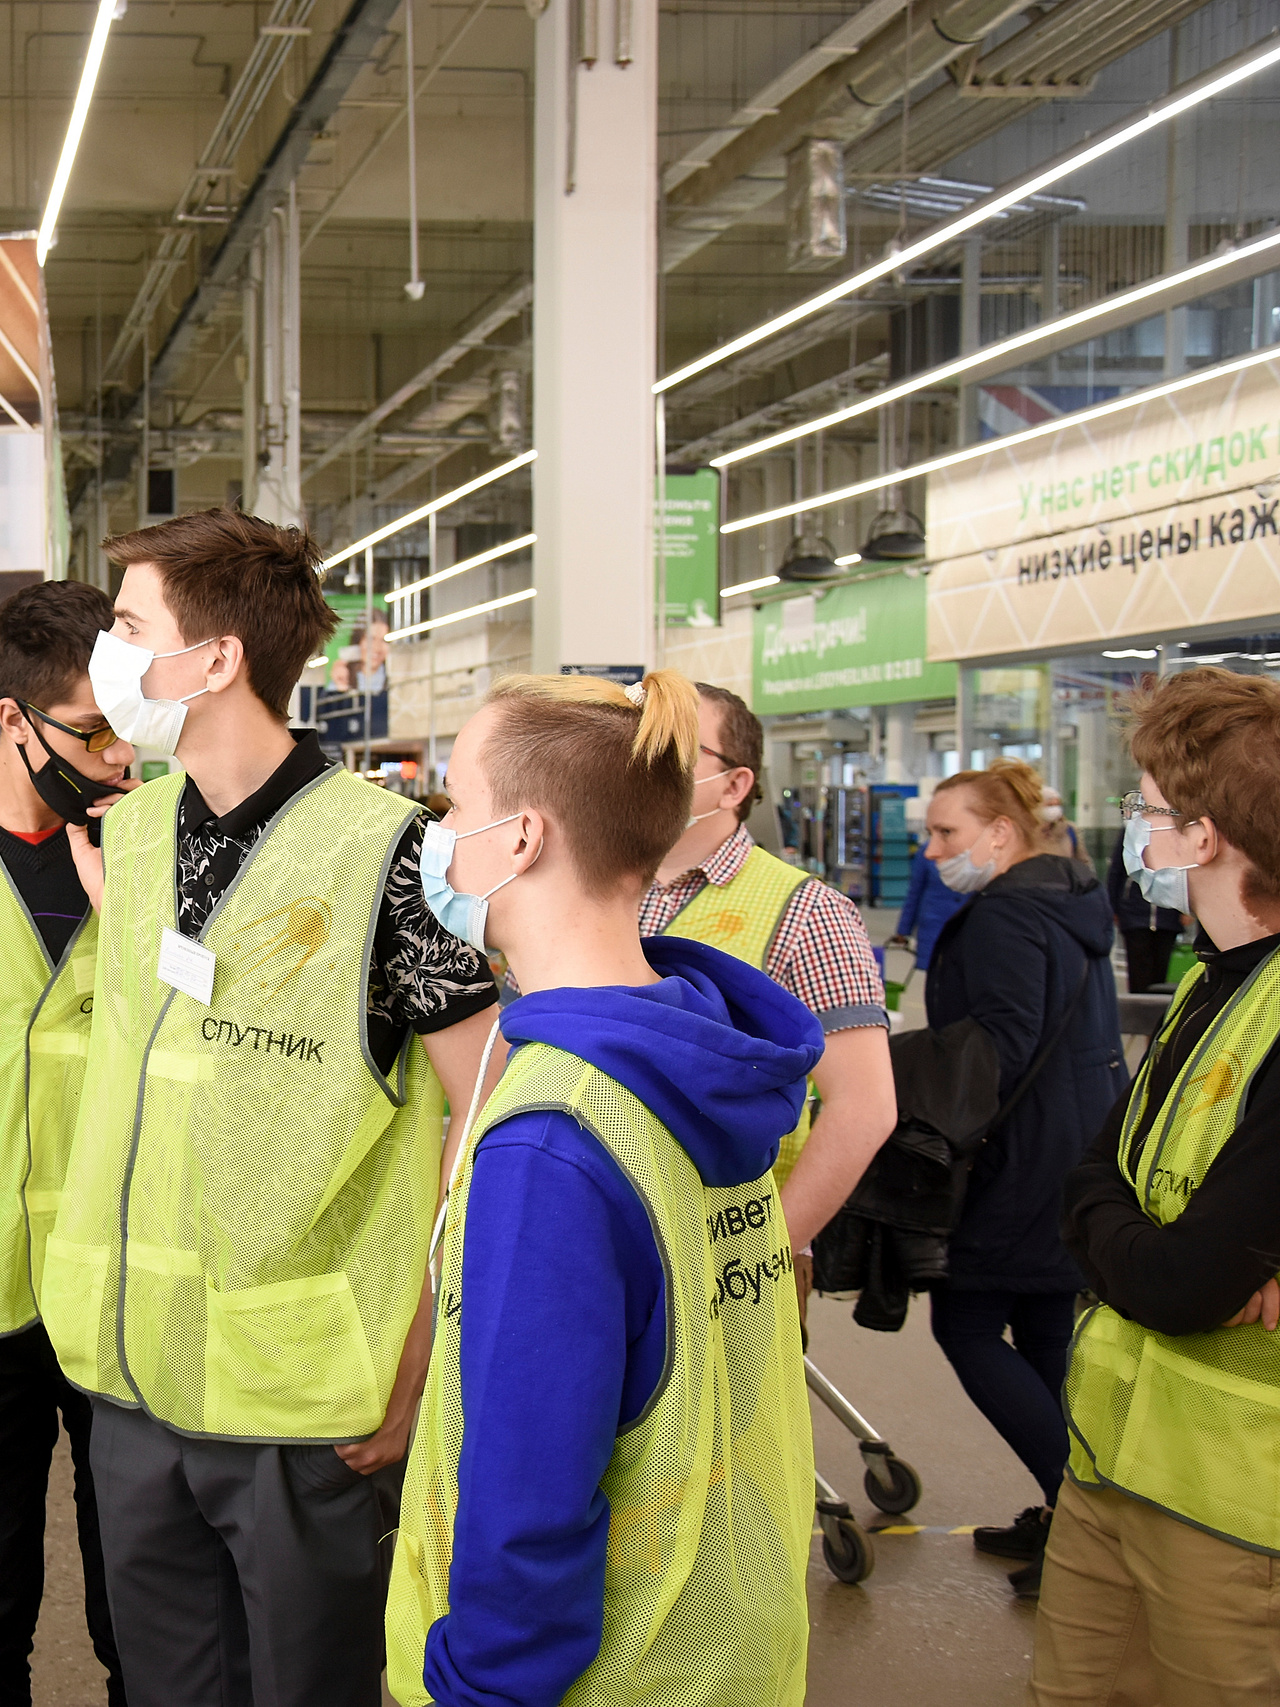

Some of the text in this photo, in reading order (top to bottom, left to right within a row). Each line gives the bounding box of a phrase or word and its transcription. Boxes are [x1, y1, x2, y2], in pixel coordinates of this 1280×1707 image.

[1018, 480, 1034, 520] У
[1040, 477, 1084, 517] нас
[1092, 461, 1140, 504] нет
[1148, 423, 1269, 488] скидок
[1018, 500, 1280, 586] низкие цены каж
[201, 1016, 325, 1064] СПУТНИК
[707, 1193, 772, 1245] ивет
